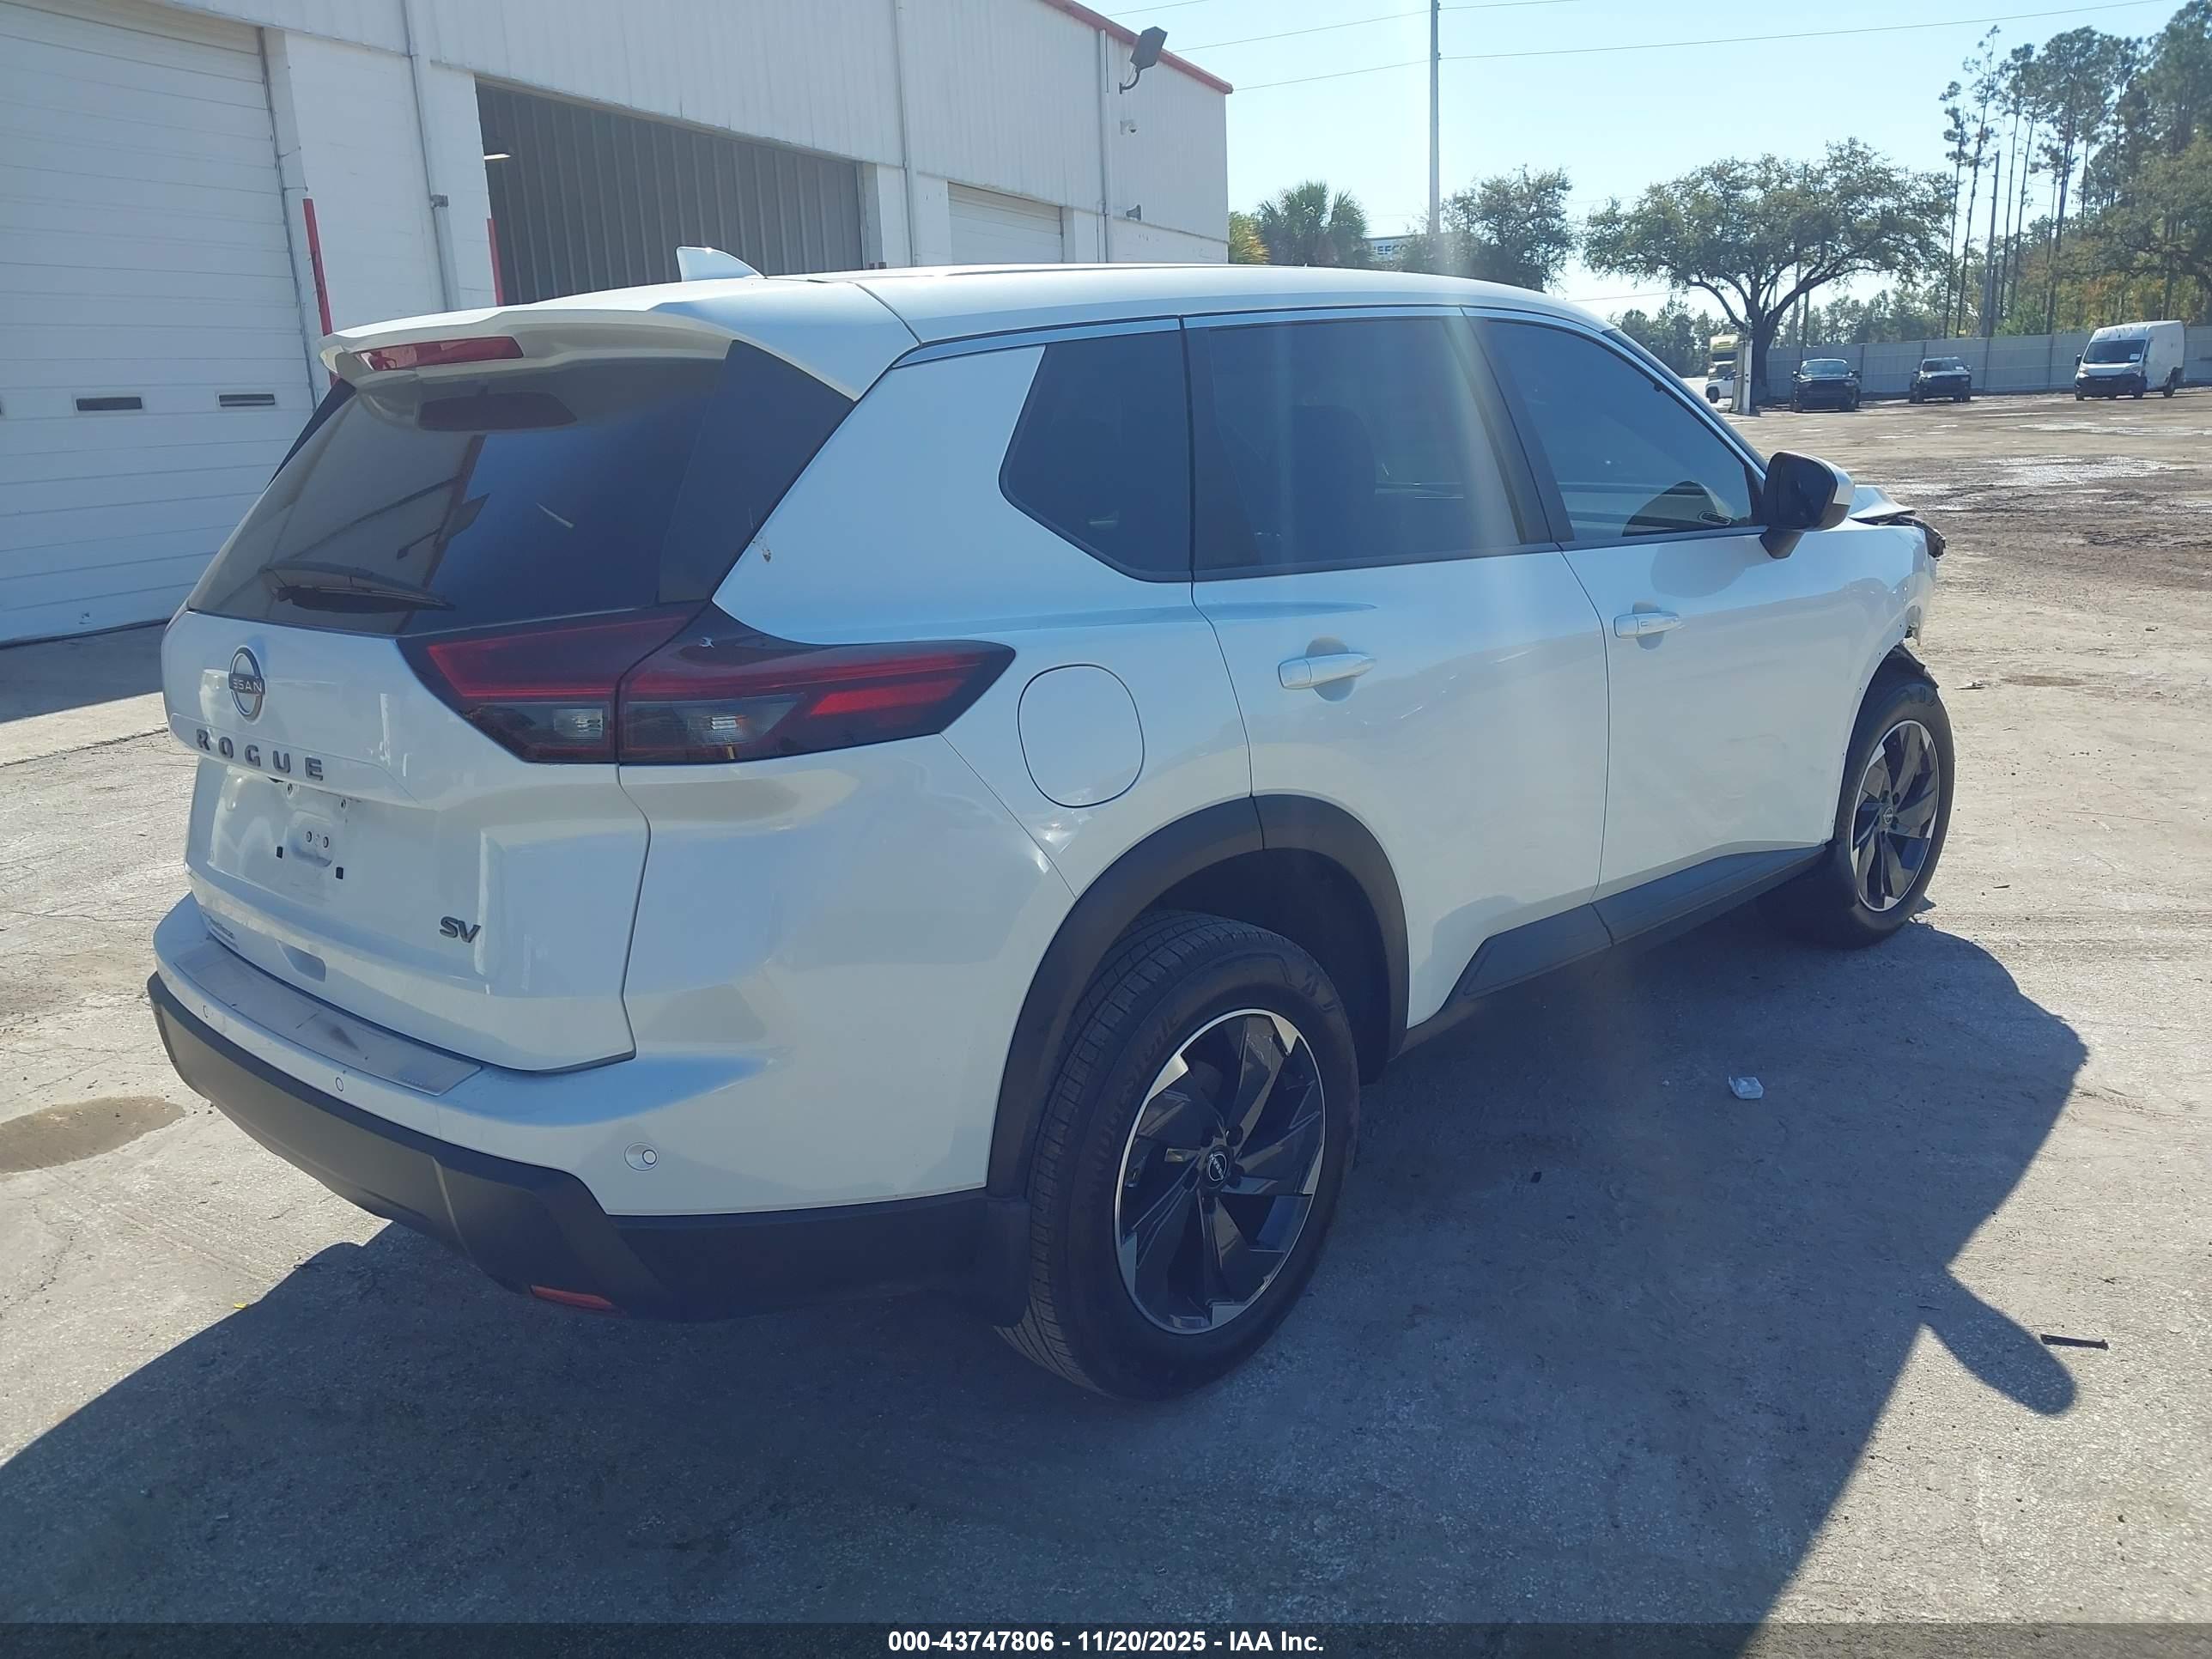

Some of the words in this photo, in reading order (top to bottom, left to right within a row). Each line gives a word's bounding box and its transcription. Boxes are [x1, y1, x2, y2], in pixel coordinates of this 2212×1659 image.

[232, 678, 263, 693] SSAN
[196, 729, 324, 781] ROGUE
[439, 915, 482, 944] SV
